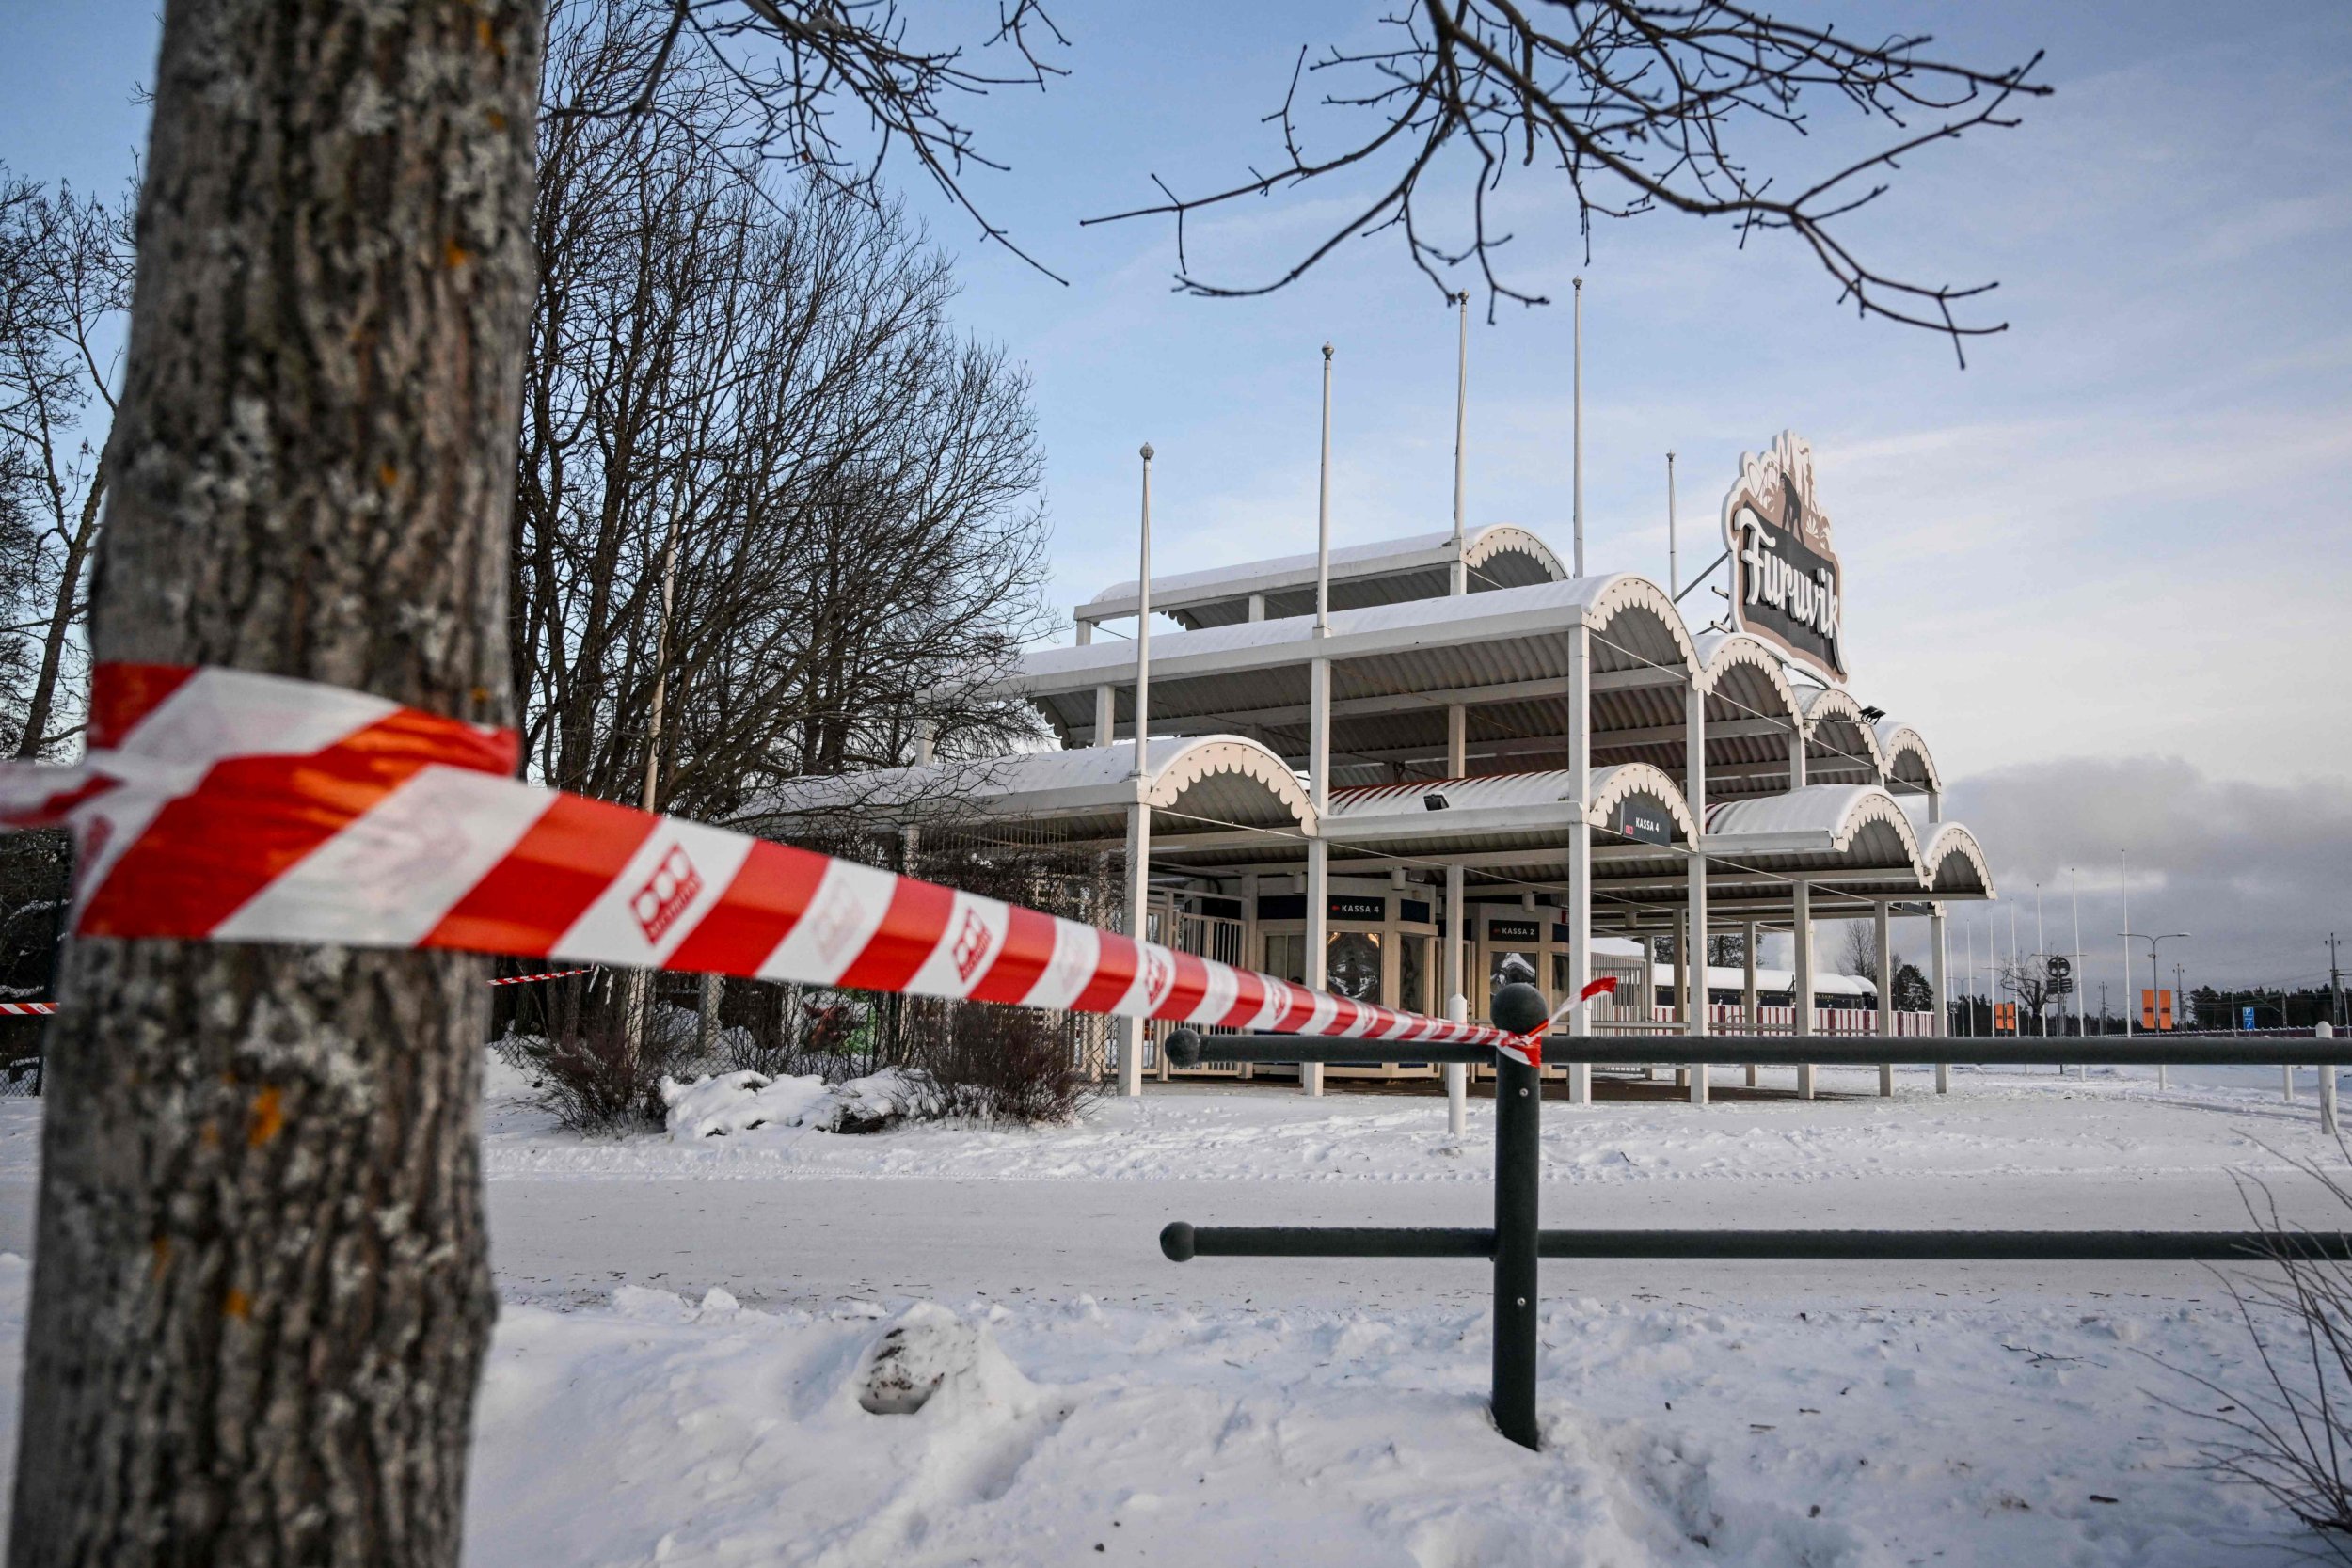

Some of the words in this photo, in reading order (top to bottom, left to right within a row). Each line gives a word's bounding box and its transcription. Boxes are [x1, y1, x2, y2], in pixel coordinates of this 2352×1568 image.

[1736, 507, 1844, 674] Furuvik
[1635, 816, 1654, 832] KASSA
[1655, 822, 1660, 833] 4
[1342, 904, 1371, 912] KASSA
[1374, 905, 1379, 913] 4
